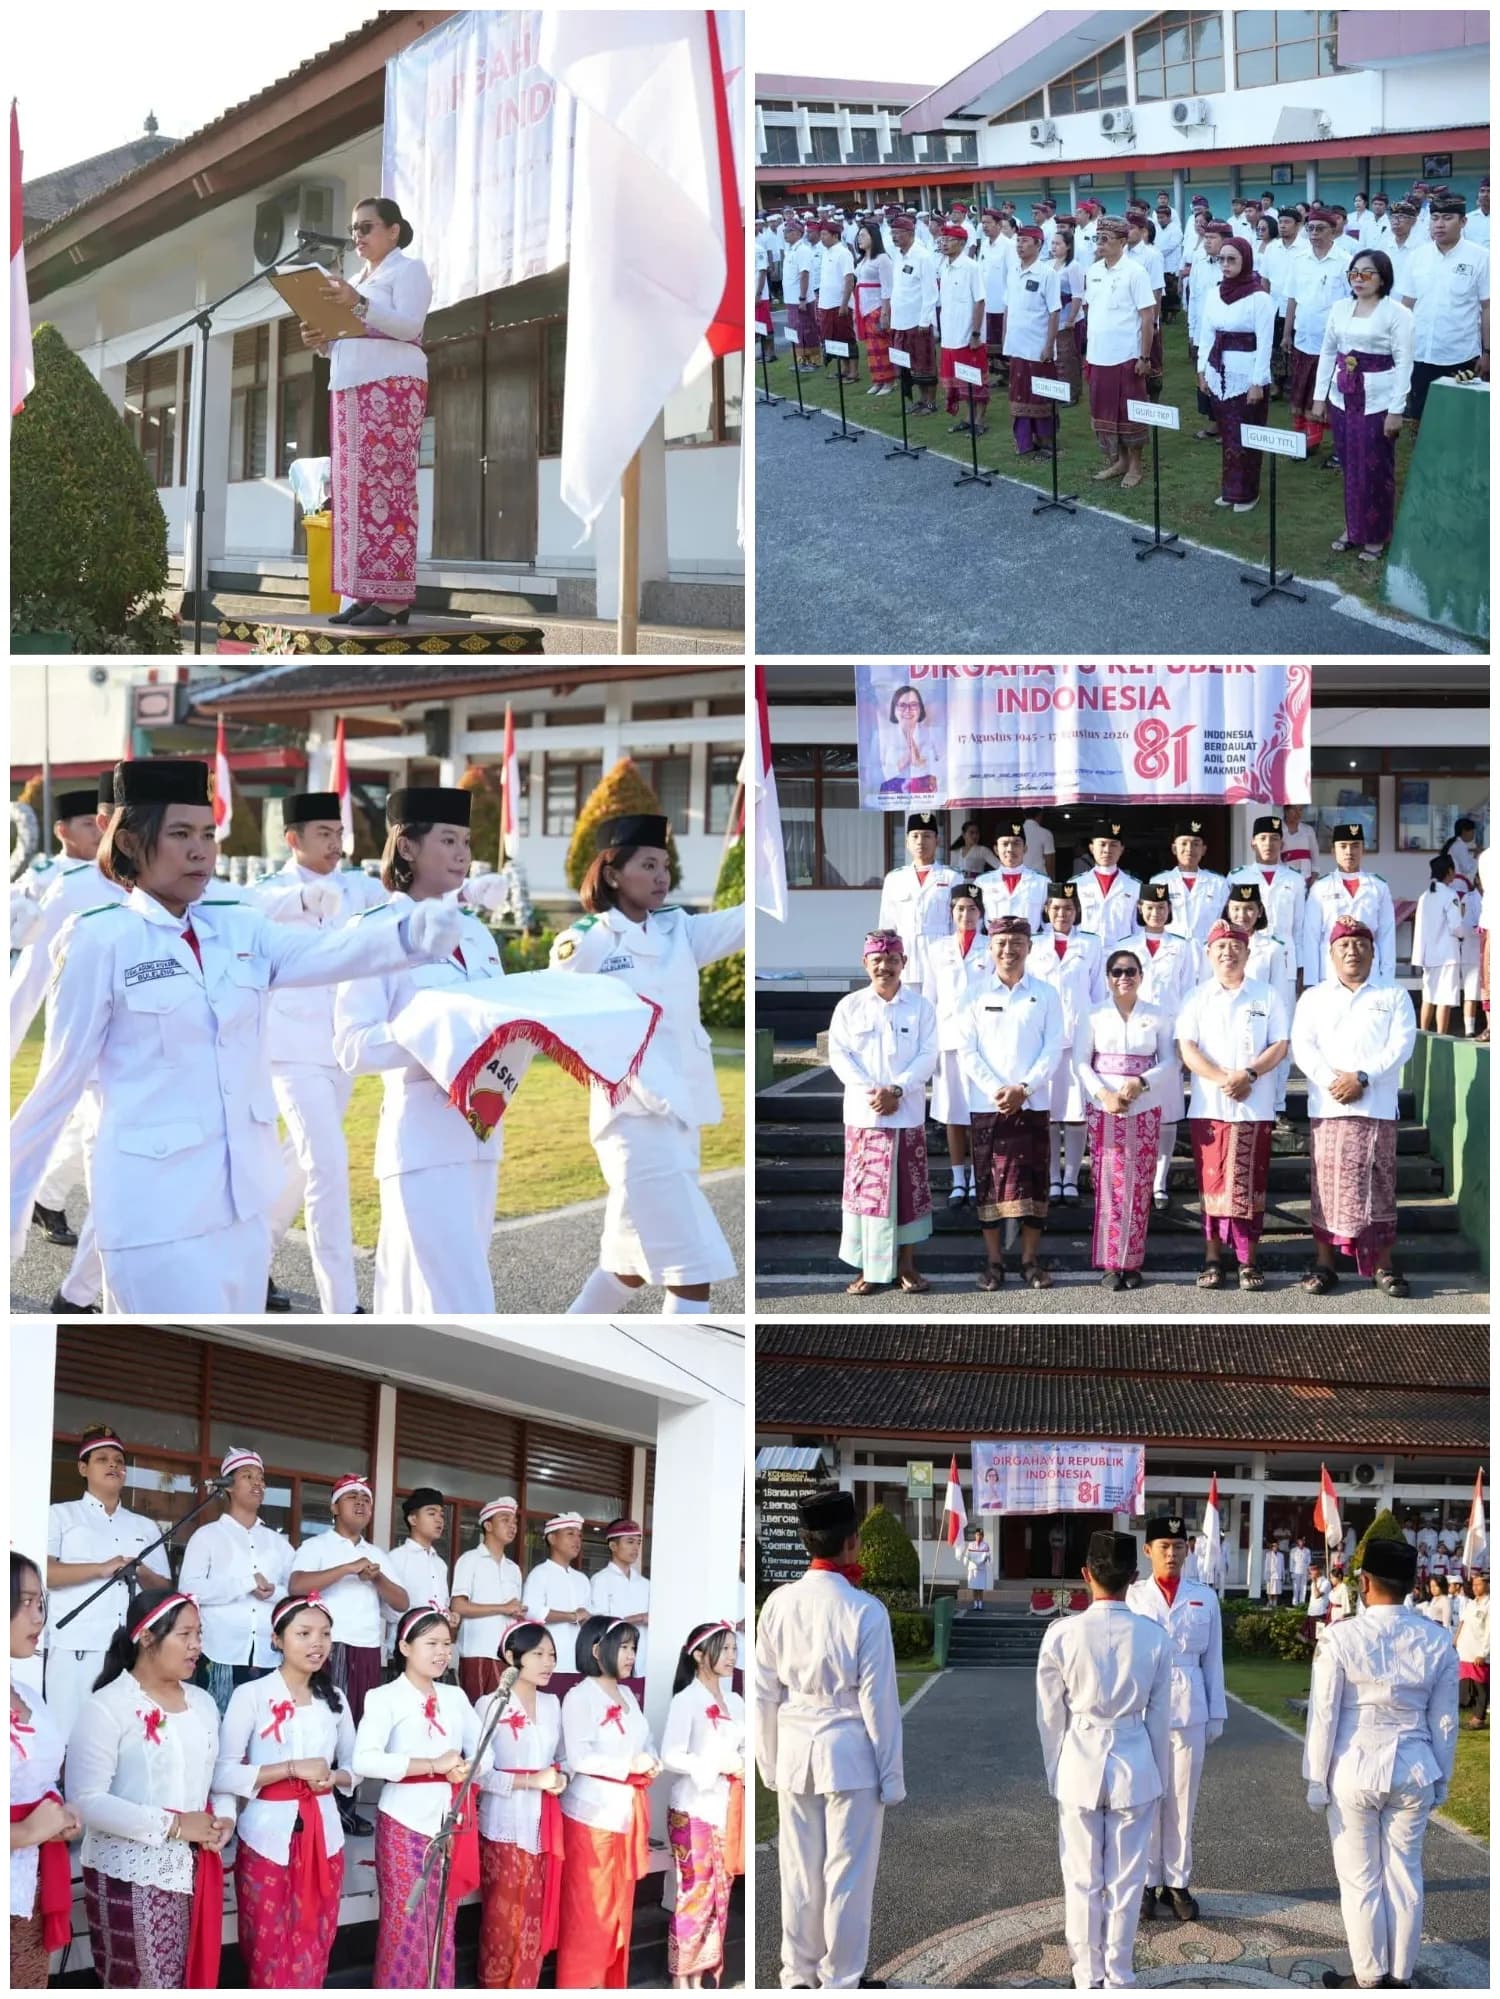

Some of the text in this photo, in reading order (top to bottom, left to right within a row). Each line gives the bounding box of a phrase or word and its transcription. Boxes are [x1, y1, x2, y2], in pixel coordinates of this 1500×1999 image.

[496, 82, 555, 139] IND
[1135, 407, 1155, 418] GURU
[1249, 432, 1275, 444] GURU
[998, 685, 1171, 713] INDONESIA
[969, 732, 1012, 744] Agustus
[1015, 733, 1037, 743] 1945
[1103, 731, 1129, 740] 2026
[1204, 730, 1254, 739] INDONESIA
[1204, 742, 1257, 751] BERDAULAT
[1134, 718, 1198, 788] 81
[1204, 754, 1246, 763] ADIL DAN
[993, 1455, 1124, 1467] DIRGAHAYU REPUBLIK
[1026, 1469, 1092, 1480] INDONESIA
[1078, 1481, 1101, 1505] 81
